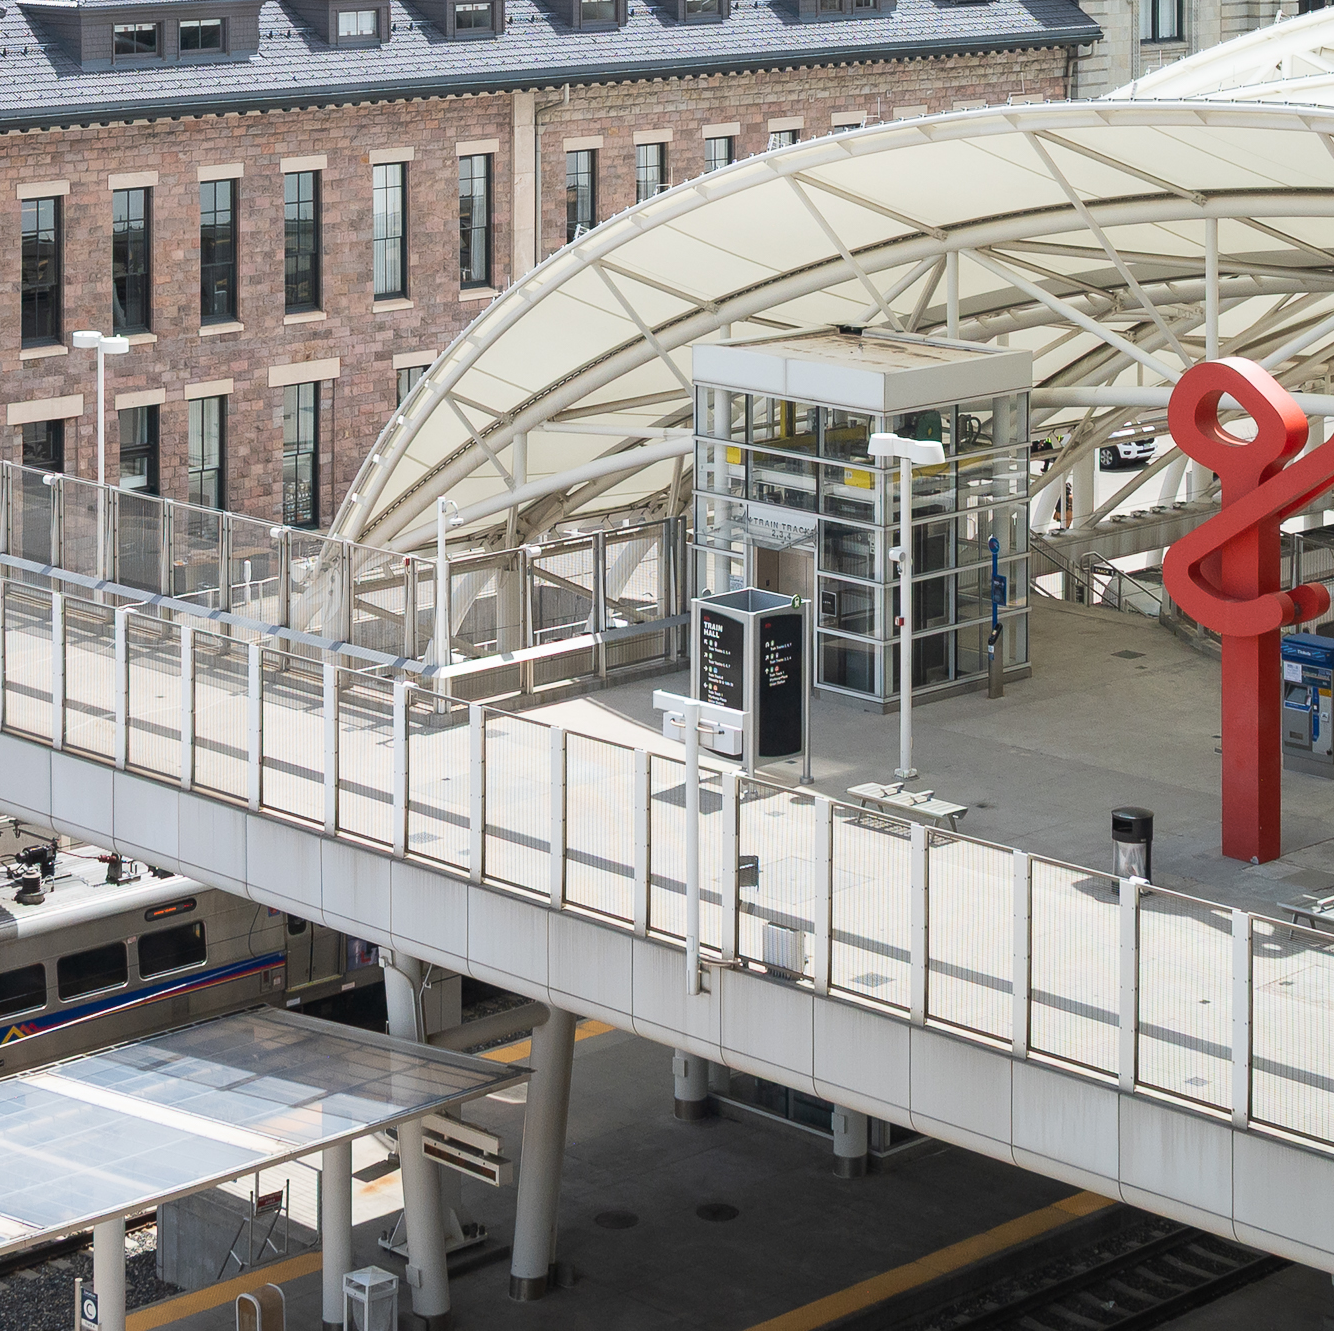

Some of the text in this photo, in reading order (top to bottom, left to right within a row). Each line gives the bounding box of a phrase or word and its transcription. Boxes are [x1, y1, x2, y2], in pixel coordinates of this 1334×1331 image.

[753, 517, 779, 529] TRAIN
[771, 529, 792, 540] 2,3,4
[703, 621, 723, 632] TRAIN
[703, 628, 720, 639] HALL
